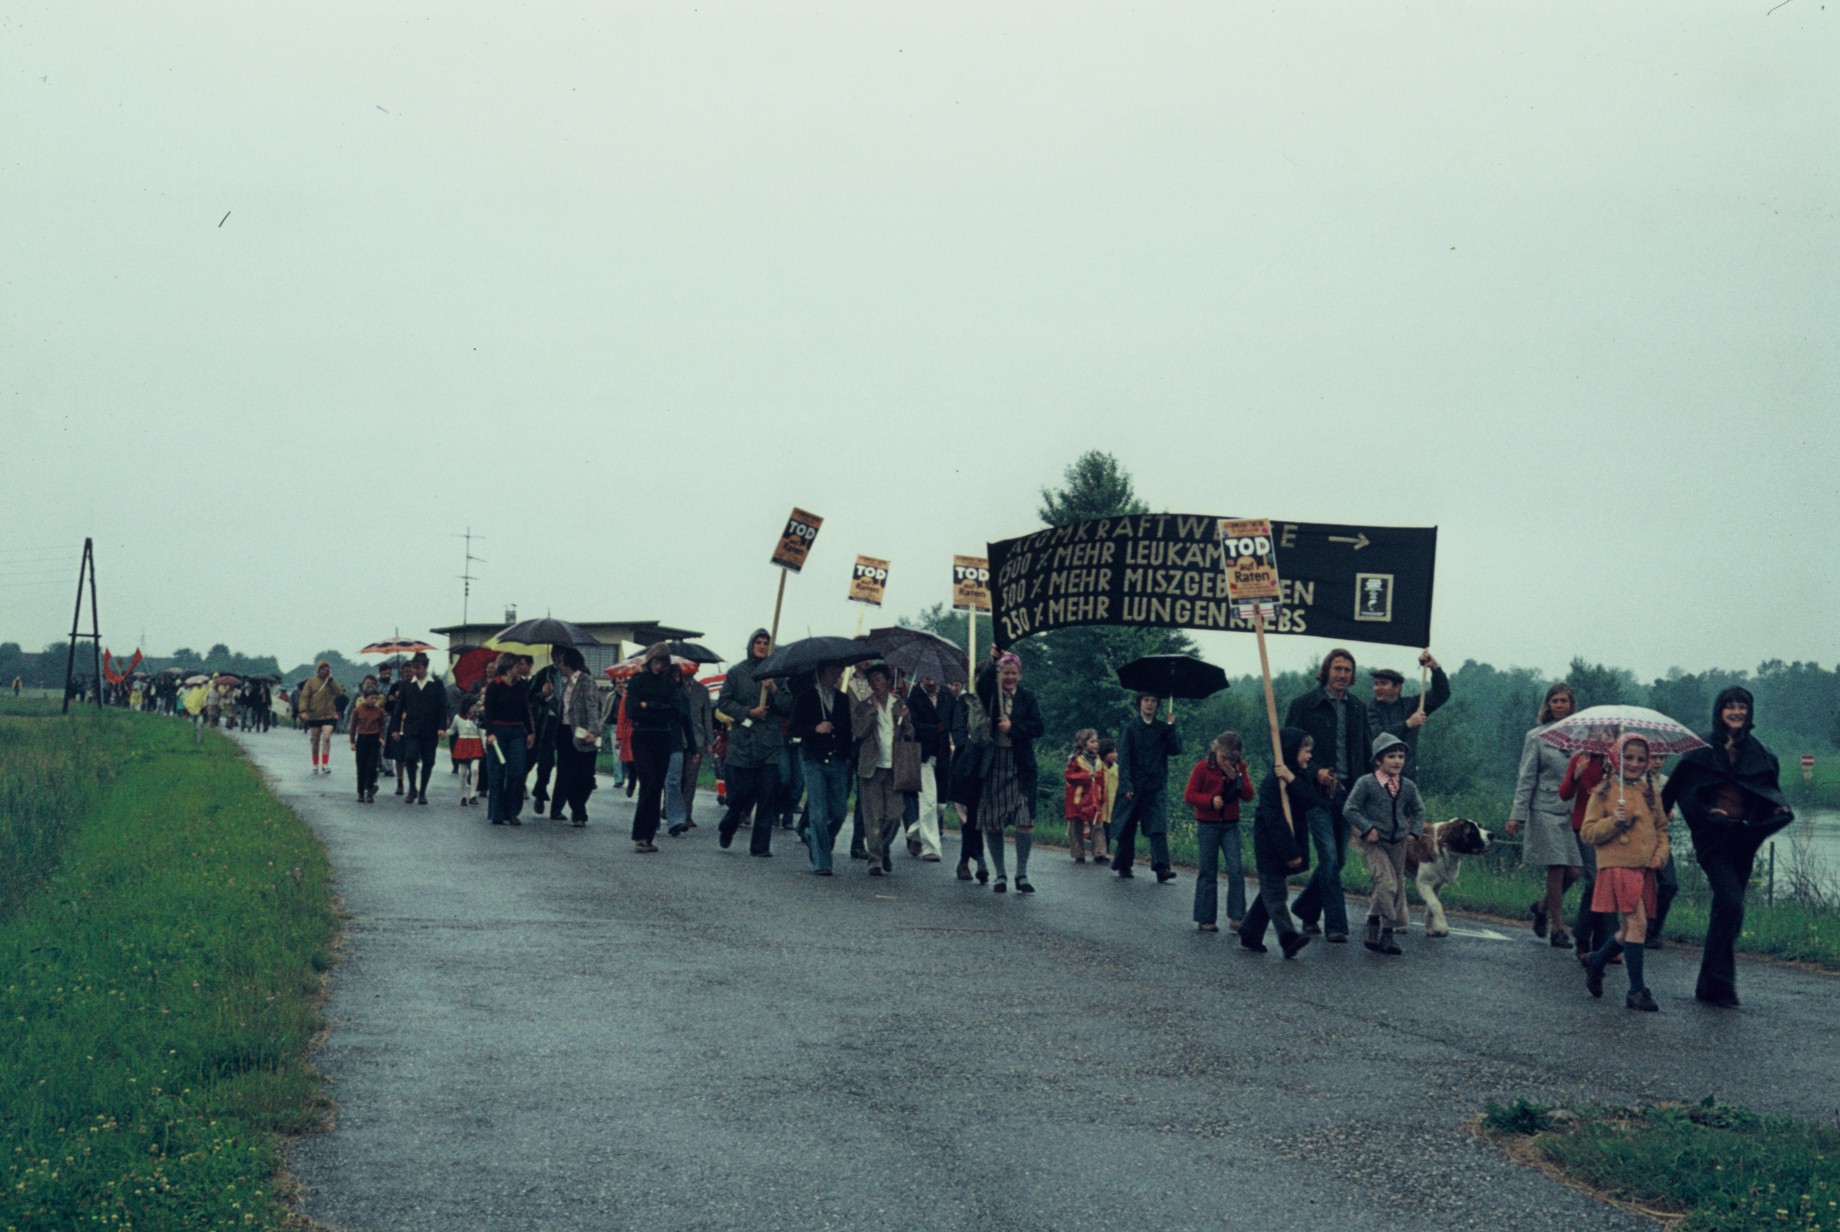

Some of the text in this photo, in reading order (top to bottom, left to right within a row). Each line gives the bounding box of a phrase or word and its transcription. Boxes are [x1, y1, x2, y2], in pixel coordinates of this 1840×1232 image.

[788, 520, 816, 540] TOD
[1006, 516, 1299, 558] ATOMKRAFTWE
[1052, 541, 1116, 569] MEHR
[1125, 540, 1227, 570] LEUKÄM
[1224, 536, 1270, 557] TOD
[856, 565, 887, 580] TOD
[955, 566, 990, 581] TOD
[1239, 560, 1255, 571] auf
[1048, 568, 1113, 596] MEHR
[1123, 568, 1315, 606] MISZGEBEN
[1234, 570, 1270, 584] Raten
[1001, 607, 1030, 639] 250
[1049, 598, 1112, 625] MEHR
